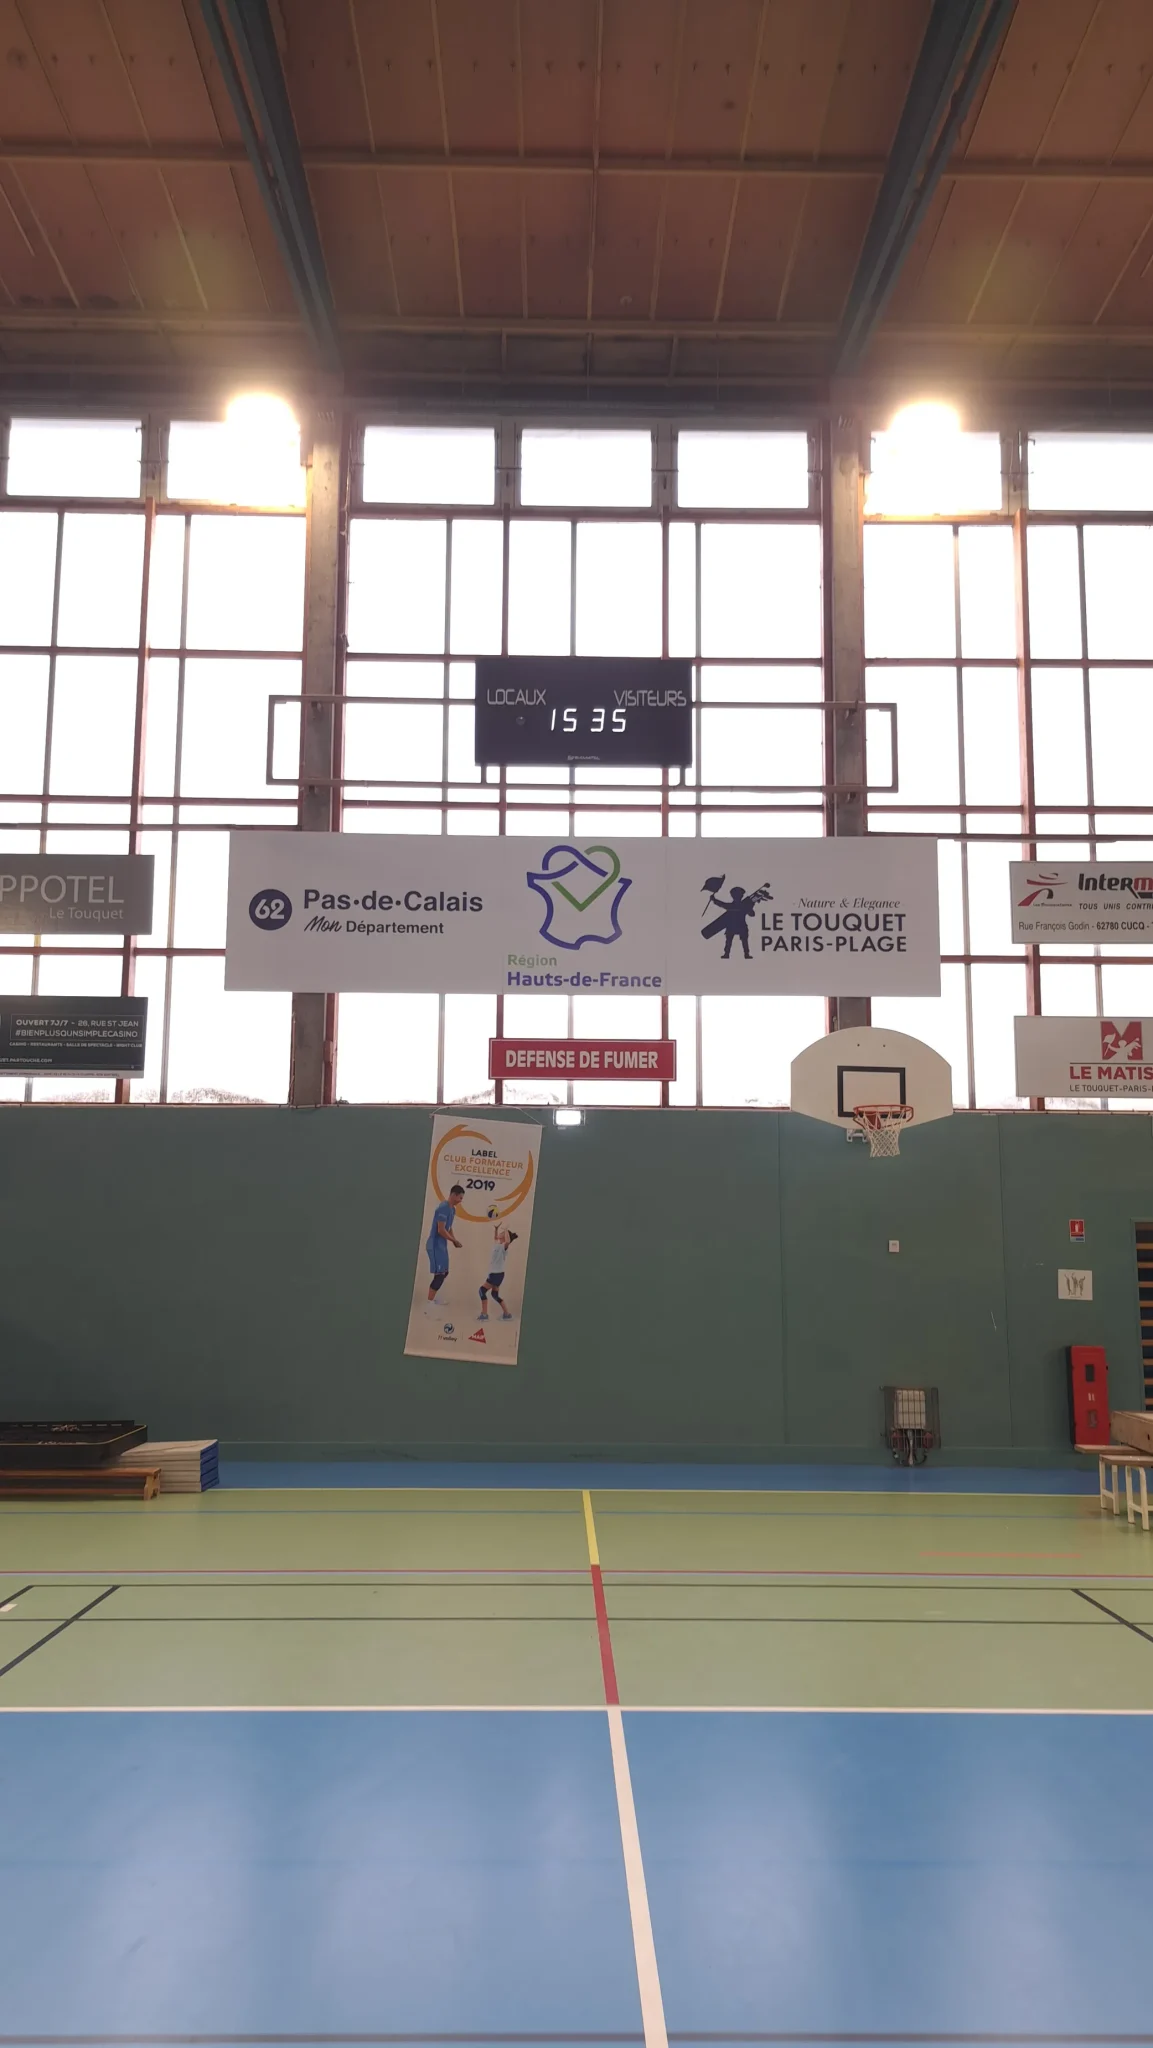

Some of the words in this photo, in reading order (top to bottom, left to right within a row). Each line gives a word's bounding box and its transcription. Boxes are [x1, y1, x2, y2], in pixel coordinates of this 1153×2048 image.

[487, 689, 546, 705] LOCAUX
[614, 690, 686, 707] VISITEURS
[254, 899, 285, 920] 62
[798, 898, 836, 909] Nature
[839, 898, 850, 908] &
[49, 907, 65, 919] Le
[68, 907, 124, 922] Touquet
[304, 916, 342, 932] Mon
[346, 920, 444, 936] Département
[761, 913, 784, 931] LE
[790, 913, 906, 932] TOUQUET
[1018, 922, 1034, 931] Rue
[1035, 921, 1066, 932] François
[1068, 921, 1090, 931] Godin
[1096, 922, 1119, 930] 62780
[1121, 922, 1145, 931] CUCQ
[761, 935, 907, 952] PARIS-PLAGE
[507, 954, 557, 968] Région
[507, 972, 662, 988] Hauts-de-France
[50, 1019, 69, 1027] 7J/7
[506, 1050, 575, 1068] DEFENSE
[580, 1051, 600, 1068] DE
[604, 1051, 659, 1069] FUMER
[1069, 1066, 1091, 1080] LE
[1082, 1085, 1153, 1093] TOUQUET-PARIS-
[471, 1149, 498, 1158] LABEL
[443, 1154, 467, 1163] CLUB
[469, 1158, 523, 1169] FORMATEUR
[454, 1165, 510, 1176] EXCELLENCE
[466, 1179, 495, 1191] 2019
